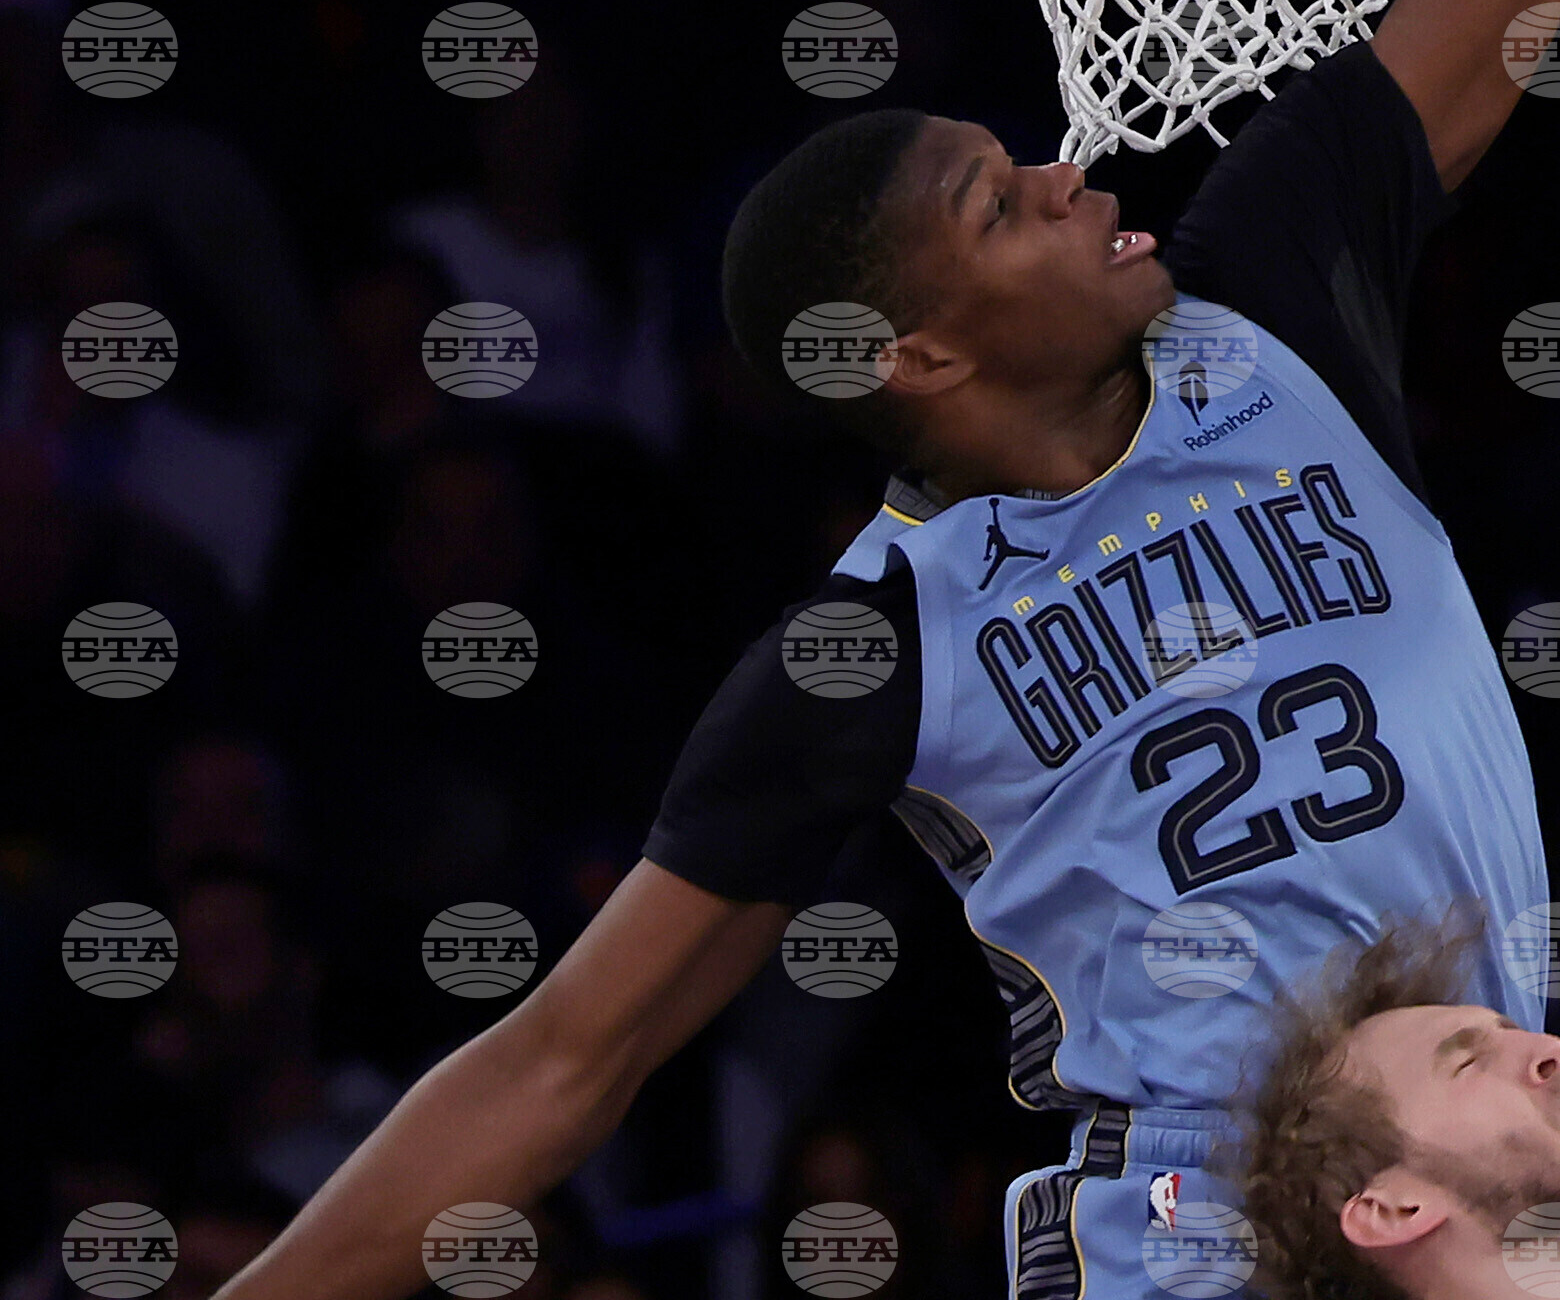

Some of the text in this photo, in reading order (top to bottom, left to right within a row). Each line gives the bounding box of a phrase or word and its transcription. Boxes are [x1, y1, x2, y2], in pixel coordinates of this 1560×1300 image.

[1183, 390, 1275, 452] Robinhood
[975, 462, 1392, 770] GRIZZLIES
[1129, 662, 1405, 897] 23
